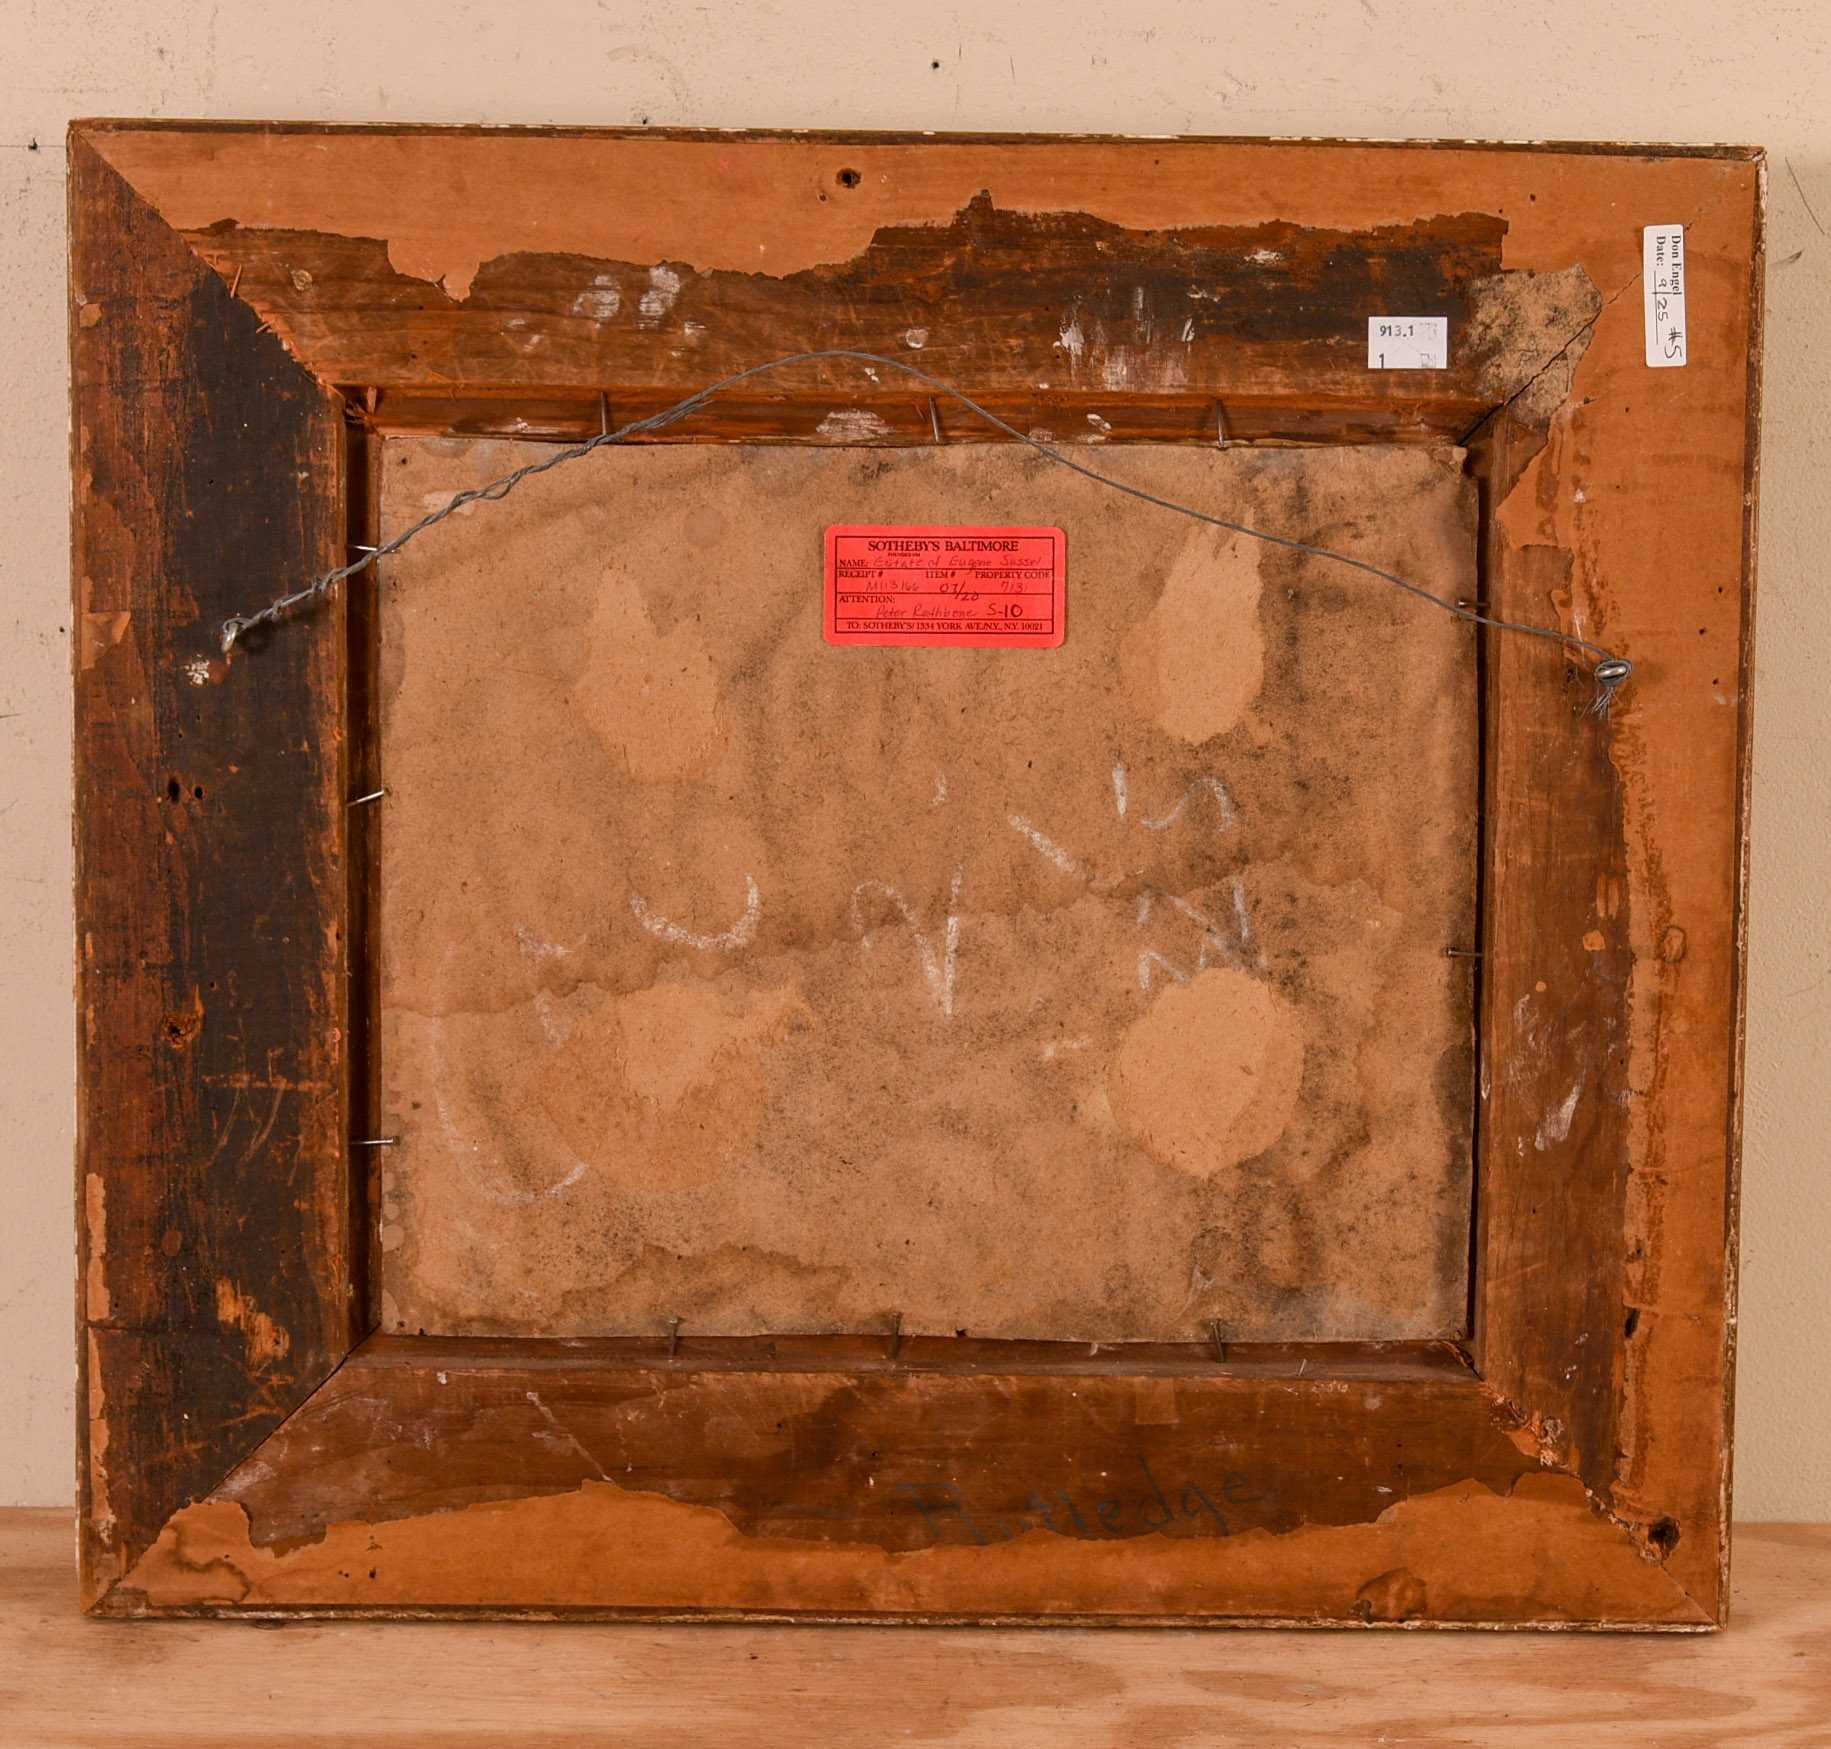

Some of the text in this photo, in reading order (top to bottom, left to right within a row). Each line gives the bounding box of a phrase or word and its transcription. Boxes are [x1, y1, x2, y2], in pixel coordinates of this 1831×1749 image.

[1656, 236, 1667, 266] Date:
[1670, 235, 1682, 295] Don Engel
[1379, 325, 1414, 337] 913.1
[1664, 326, 1683, 359] #5
[1378, 353, 1385, 368] 1
[868, 540, 1019, 552] SOTHEBY'S BALTIMORE
[874, 557, 923, 568] Estate
[928, 555, 941, 567] of
[949, 555, 992, 575] Eugene
[839, 570, 876, 578] RECEIPT
[926, 571, 948, 579] ITEM
[975, 571, 1050, 579] PROPERTY CODE
[839, 595, 895, 603] ATTENTION:
[847, 621, 861, 630] TO:
[937, 622, 962, 631] YORK
[1022, 622, 1043, 630] 10021
